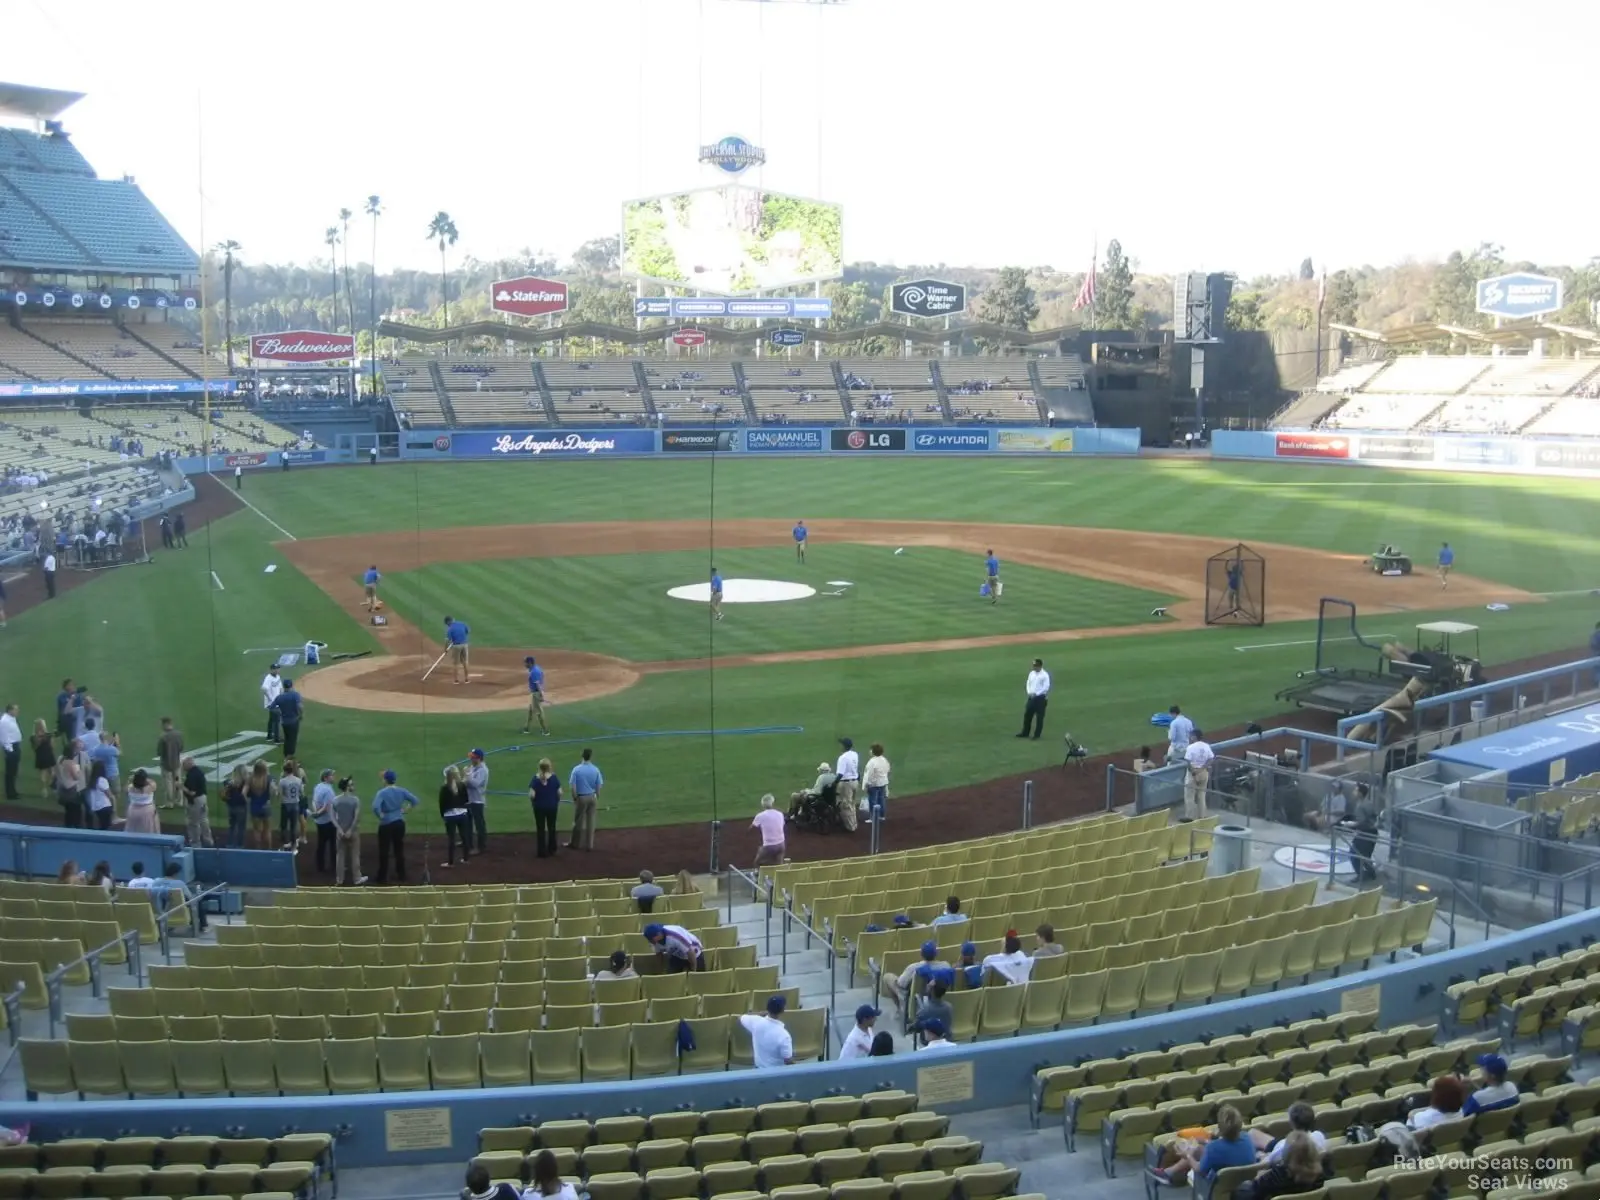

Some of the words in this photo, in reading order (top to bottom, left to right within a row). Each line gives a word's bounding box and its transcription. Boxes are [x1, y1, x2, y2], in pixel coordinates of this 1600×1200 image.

[927, 286, 948, 294] Time
[926, 302, 950, 310] Cable
[256, 339, 352, 354] Budweiser
[749, 433, 770, 441] SAN
[778, 433, 819, 441] MANUEL
[869, 434, 890, 446] LG
[939, 435, 988, 444] HYUNDAI
[492, 435, 515, 452] Los
[514, 435, 567, 454] Angeles
[564, 434, 615, 453] Dodgers
[1279, 441, 1295, 449] Bank
